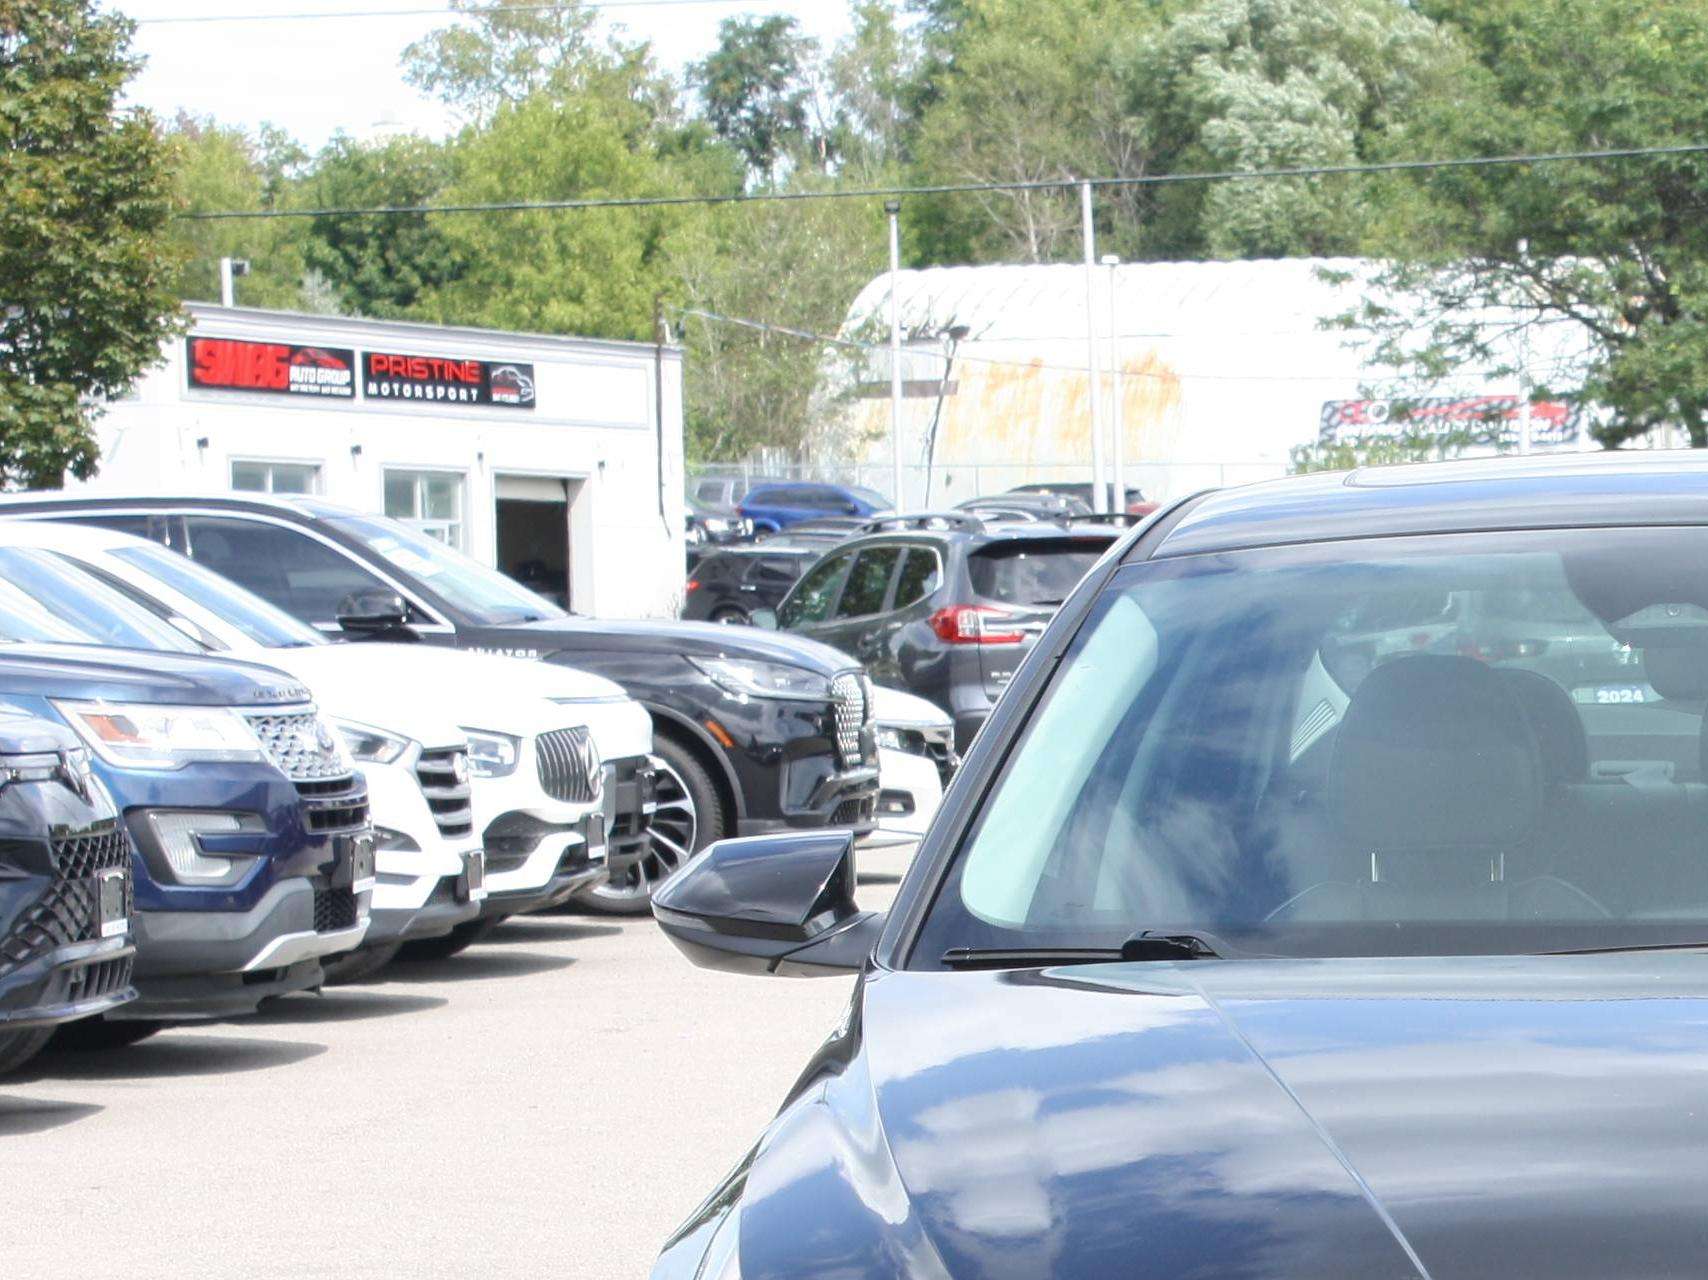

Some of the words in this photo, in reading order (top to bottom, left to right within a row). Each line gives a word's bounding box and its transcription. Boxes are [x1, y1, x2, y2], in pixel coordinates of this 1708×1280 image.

[290, 366, 316, 384] AUTO
[370, 353, 481, 384] PRISTINE
[367, 382, 478, 402] MOTORSPORT
[1597, 689, 1645, 704] 2024
